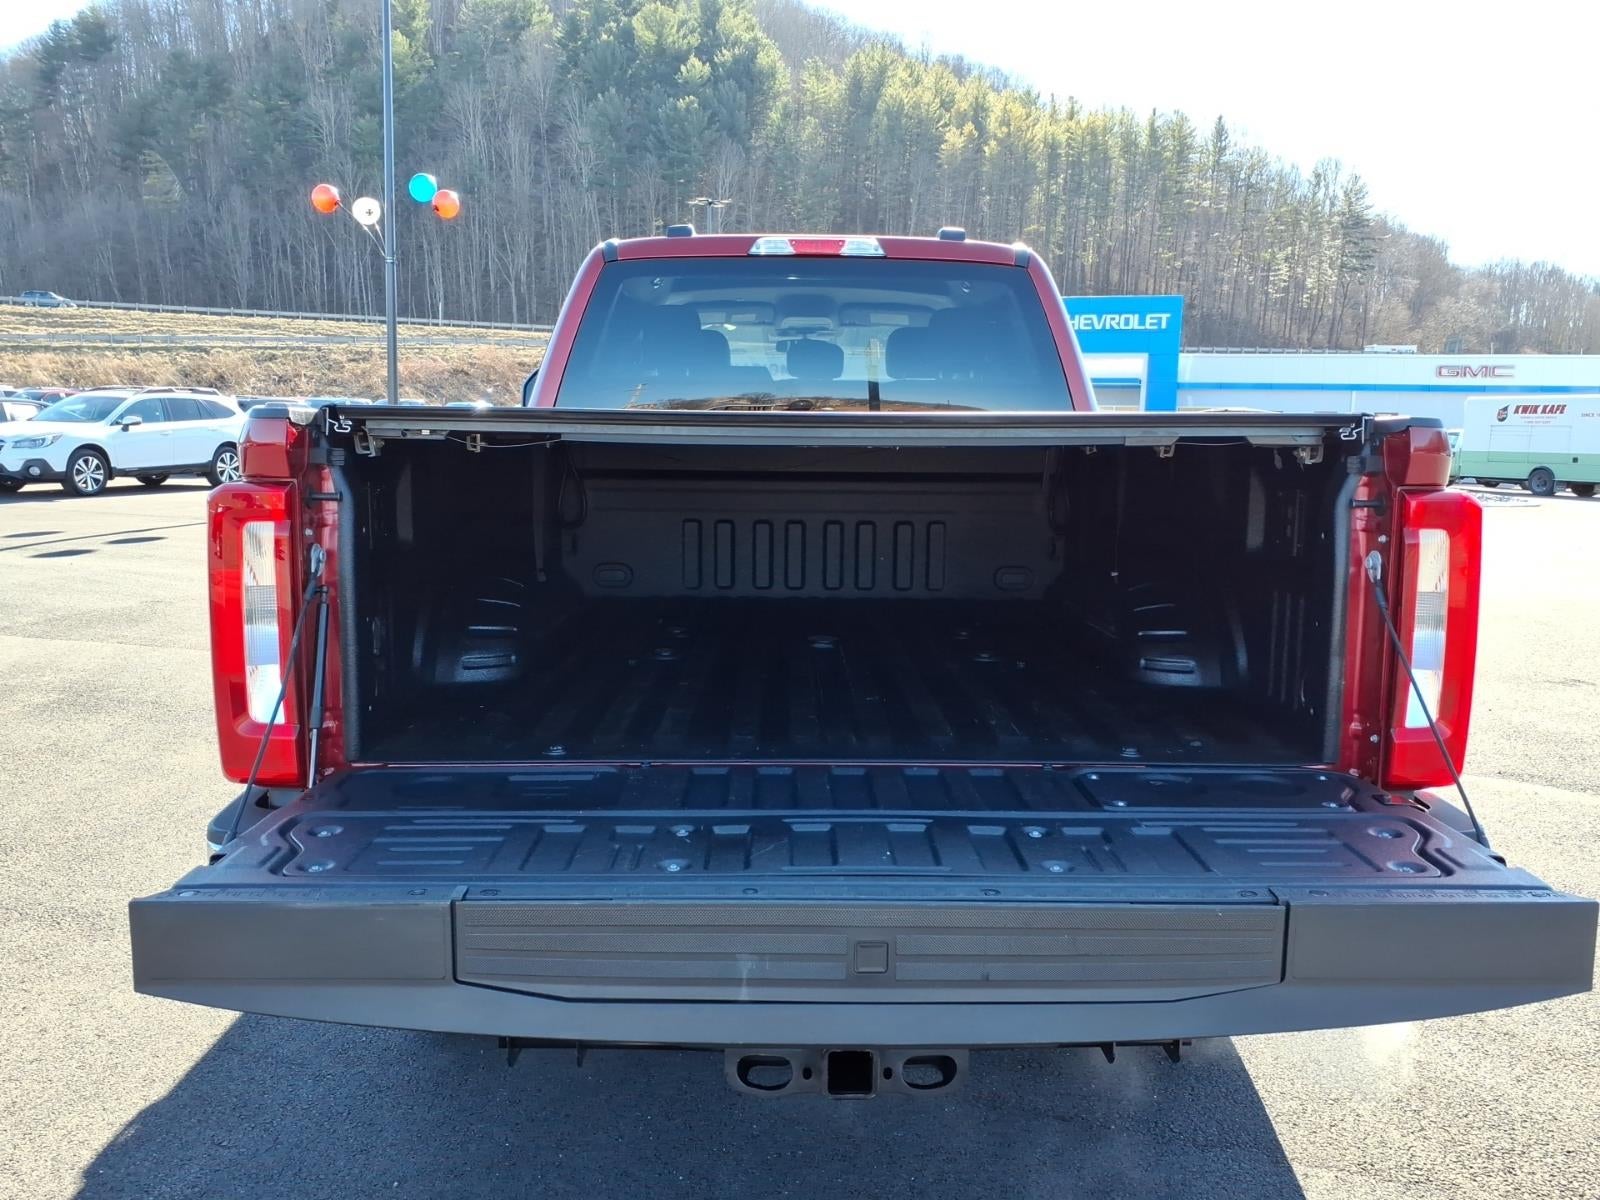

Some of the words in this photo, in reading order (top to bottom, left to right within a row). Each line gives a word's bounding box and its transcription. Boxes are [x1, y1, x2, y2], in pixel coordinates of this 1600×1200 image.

[1069, 313, 1171, 330] HEVROLET
[1436, 364, 1515, 378] GMC
[1513, 404, 1541, 415] KWIK
[1540, 404, 1567, 415] KAFE
